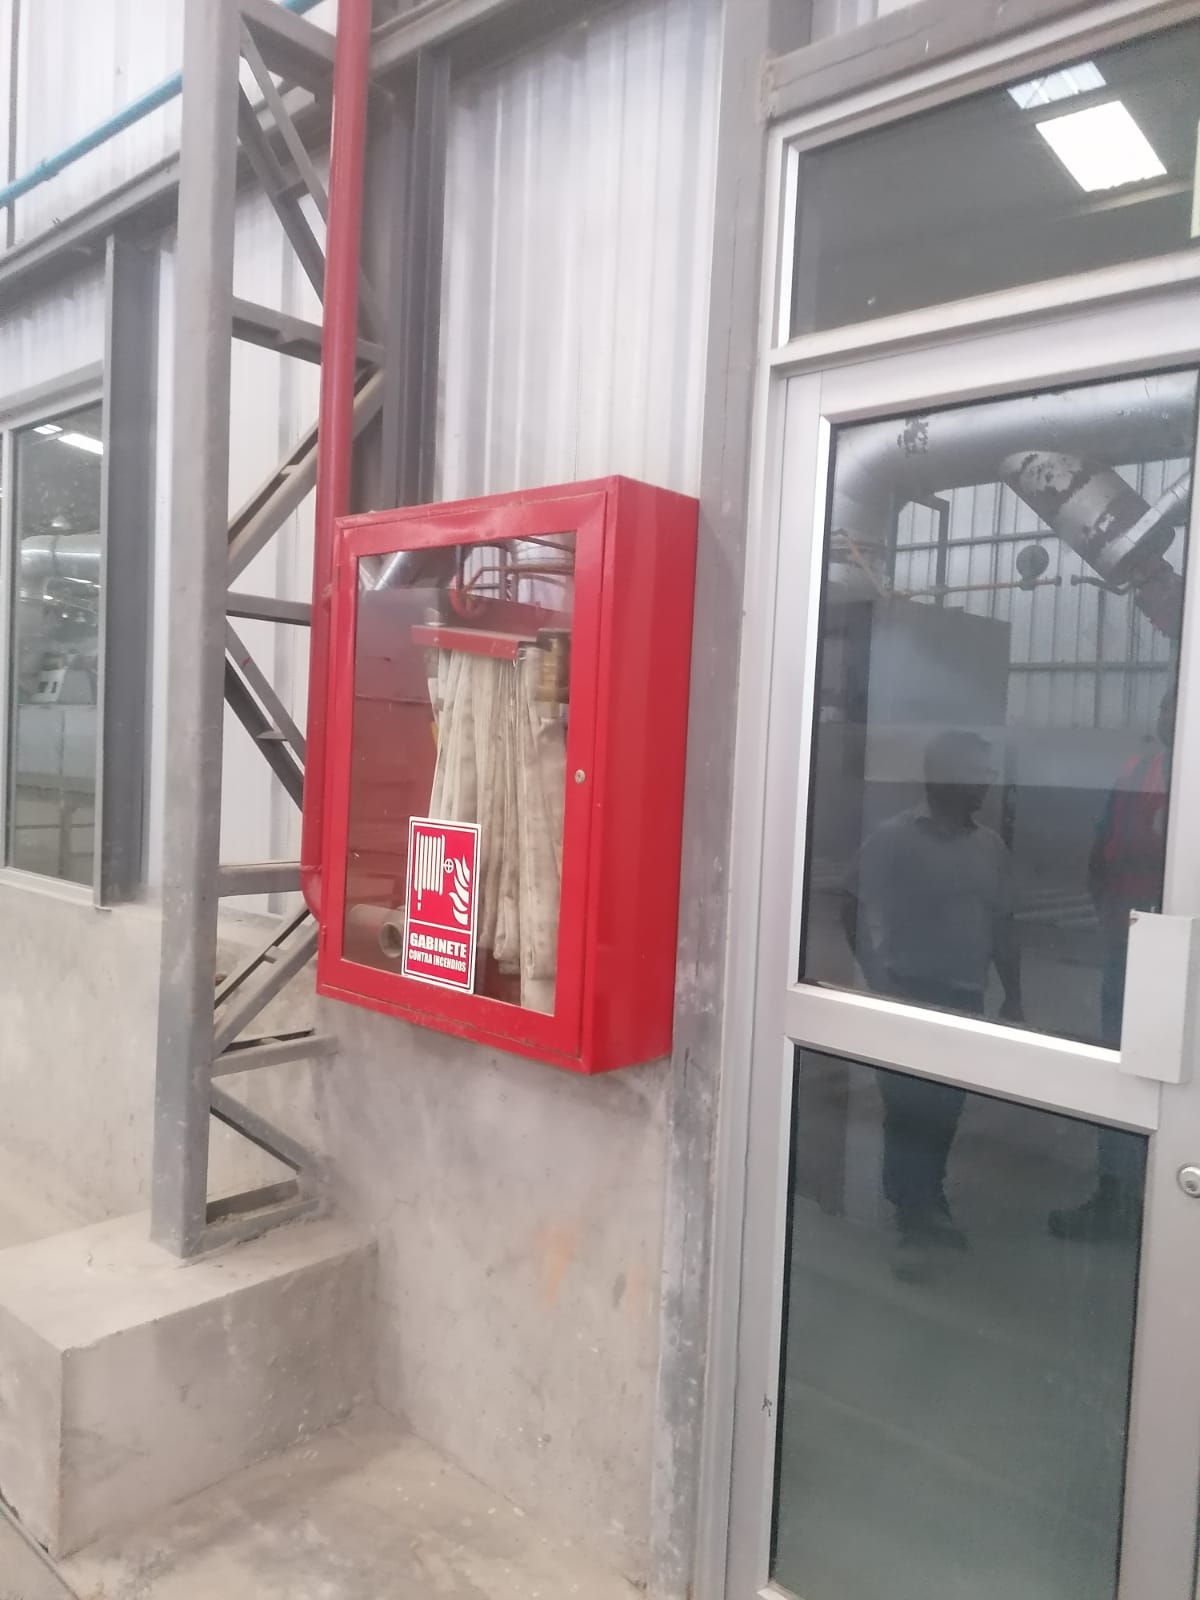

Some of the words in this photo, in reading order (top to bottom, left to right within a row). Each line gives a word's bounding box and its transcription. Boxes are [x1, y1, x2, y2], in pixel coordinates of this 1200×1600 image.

[410, 932, 467, 958] GABINETE
[409, 949, 432, 964] CONTRA
[433, 954, 466, 972] INCENDIOS
